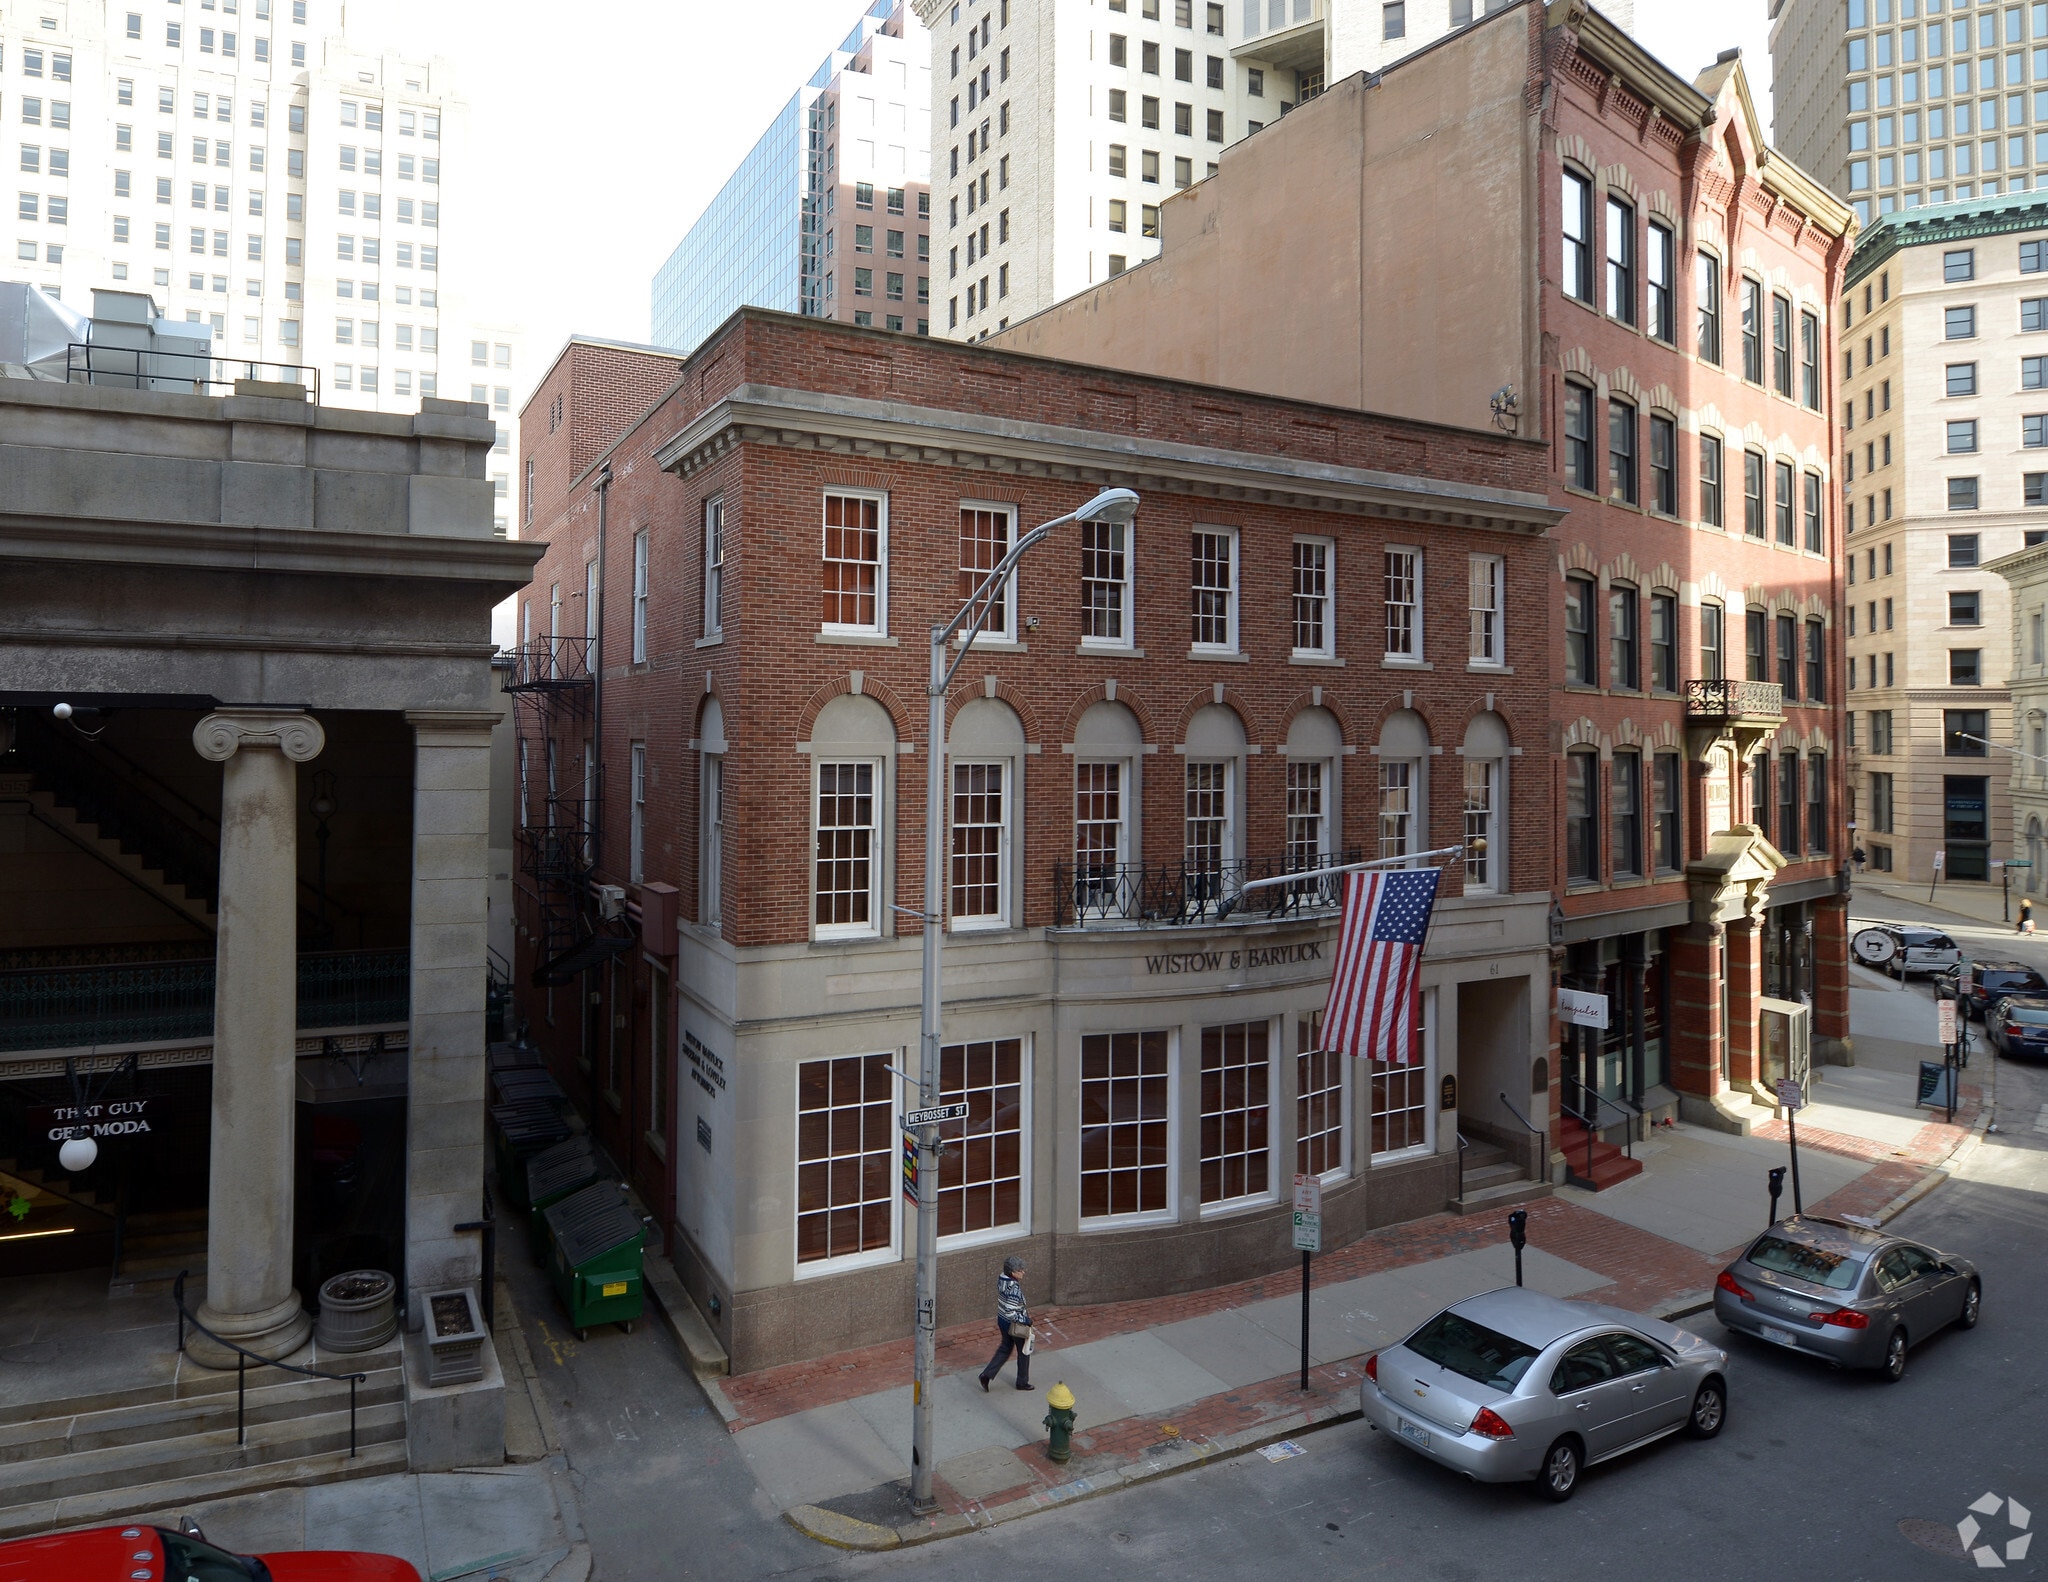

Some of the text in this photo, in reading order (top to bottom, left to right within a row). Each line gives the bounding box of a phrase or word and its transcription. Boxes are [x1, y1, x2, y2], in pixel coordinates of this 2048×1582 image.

[1145, 942, 1322, 974] WISTOW & BARYLICK
[1490, 963, 1499, 976] 61
[1561, 999, 1599, 1016] Impulse
[108, 1100, 148, 1115] GUY
[909, 1105, 965, 1124] WEYBOSSET ST
[93, 1120, 152, 1137] MODA
[1295, 1213, 1302, 1222] 2
